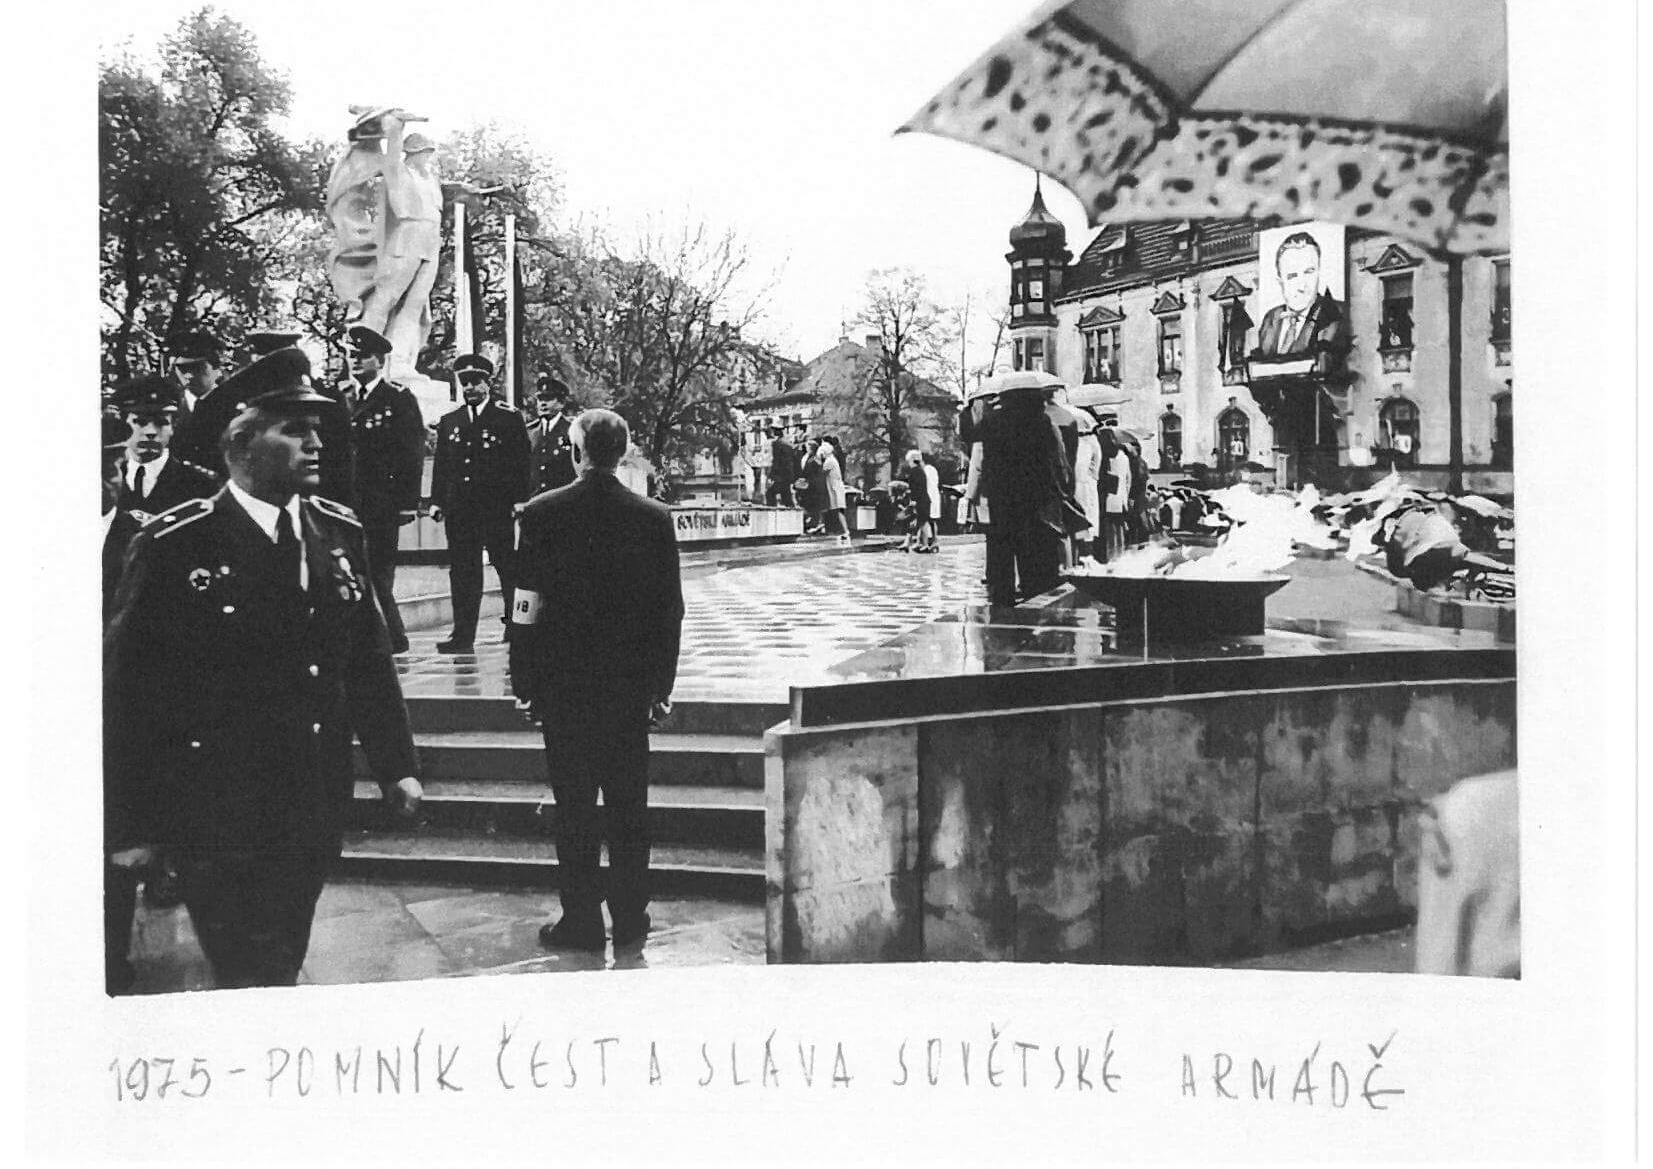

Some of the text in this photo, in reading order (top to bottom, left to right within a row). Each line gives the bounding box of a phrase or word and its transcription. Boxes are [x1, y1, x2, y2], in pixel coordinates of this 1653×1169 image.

[107, 1057, 212, 1102] 1975
[265, 1027, 463, 1097] POMNÍK
[496, 1022, 620, 1090] ČEST
[647, 1040, 662, 1086] A
[697, 1028, 852, 1088] SLÁVA
[892, 1022, 1122, 1094] SOVĚTSKÉ
[1179, 1032, 1406, 1111] ARMÁDĚ
